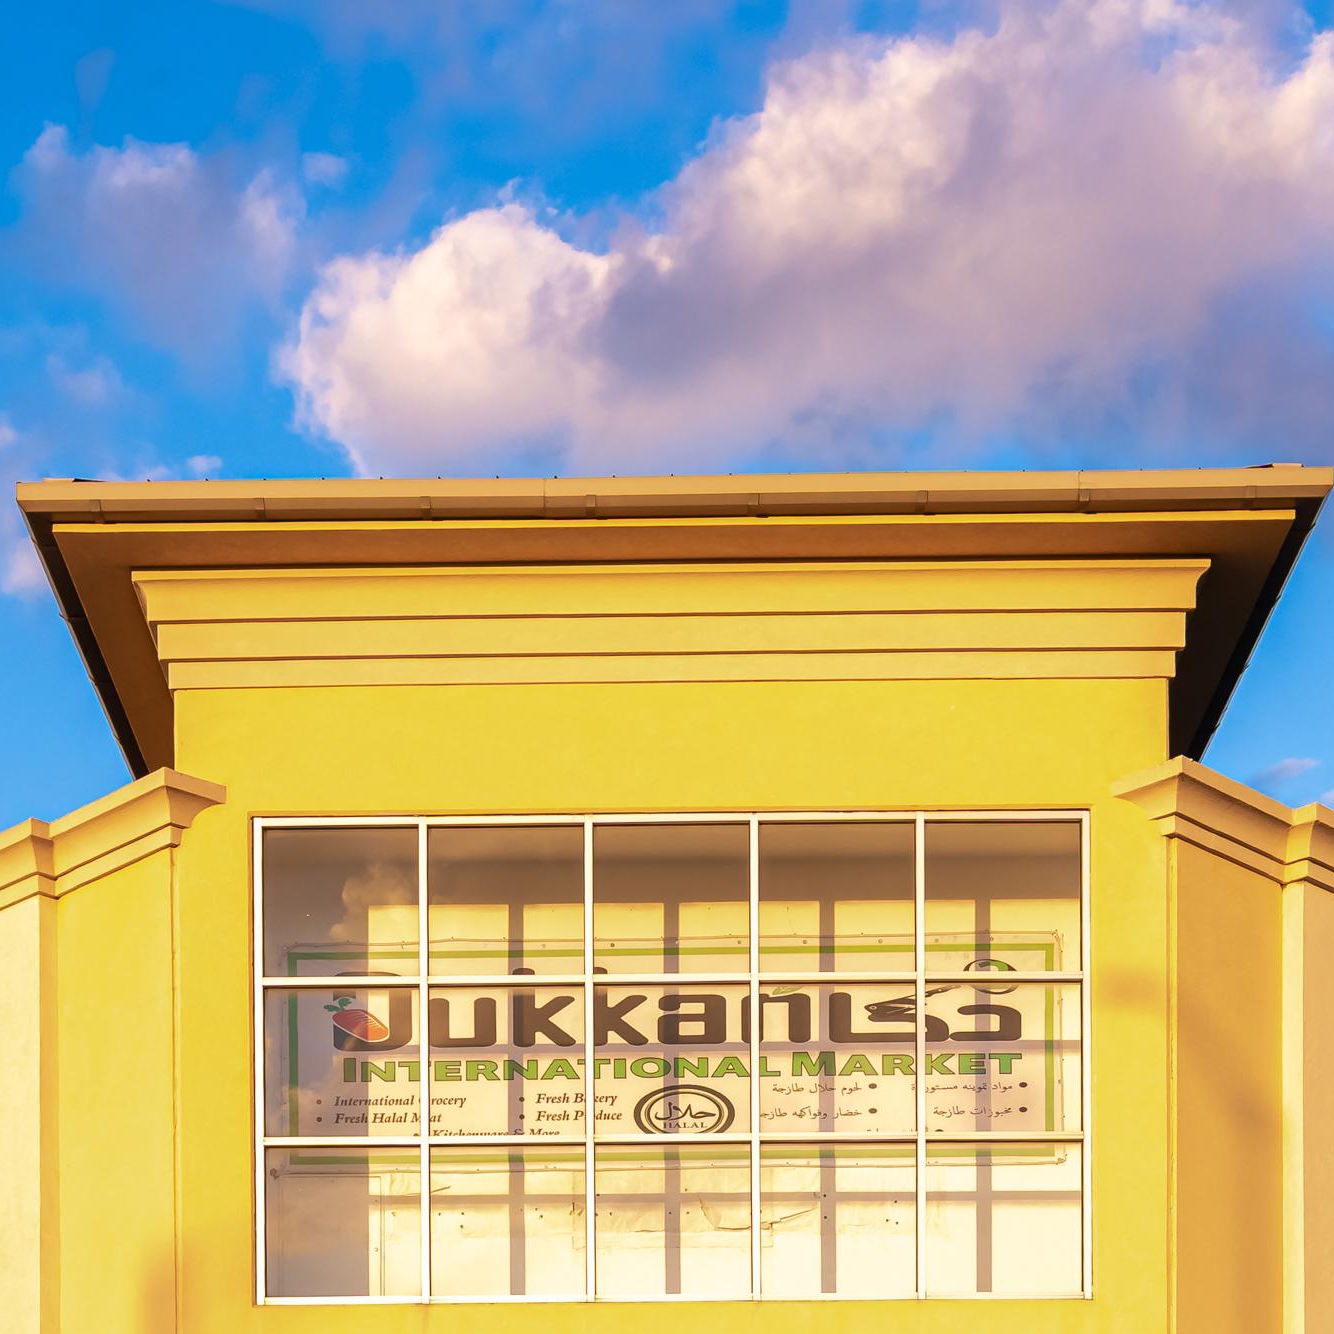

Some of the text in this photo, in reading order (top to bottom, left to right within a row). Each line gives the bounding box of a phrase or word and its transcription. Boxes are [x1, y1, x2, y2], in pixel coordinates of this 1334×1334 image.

[343, 1051, 1022, 1083] INTERNATIONAL MARKET
[334, 1095, 466, 1109] International rocery
[536, 1093, 570, 1104] Fresh
[334, 1112, 442, 1124] Fresh Halal Mat
[536, 1109, 570, 1121] Fresh
[663, 1121, 707, 1129] HALAL
